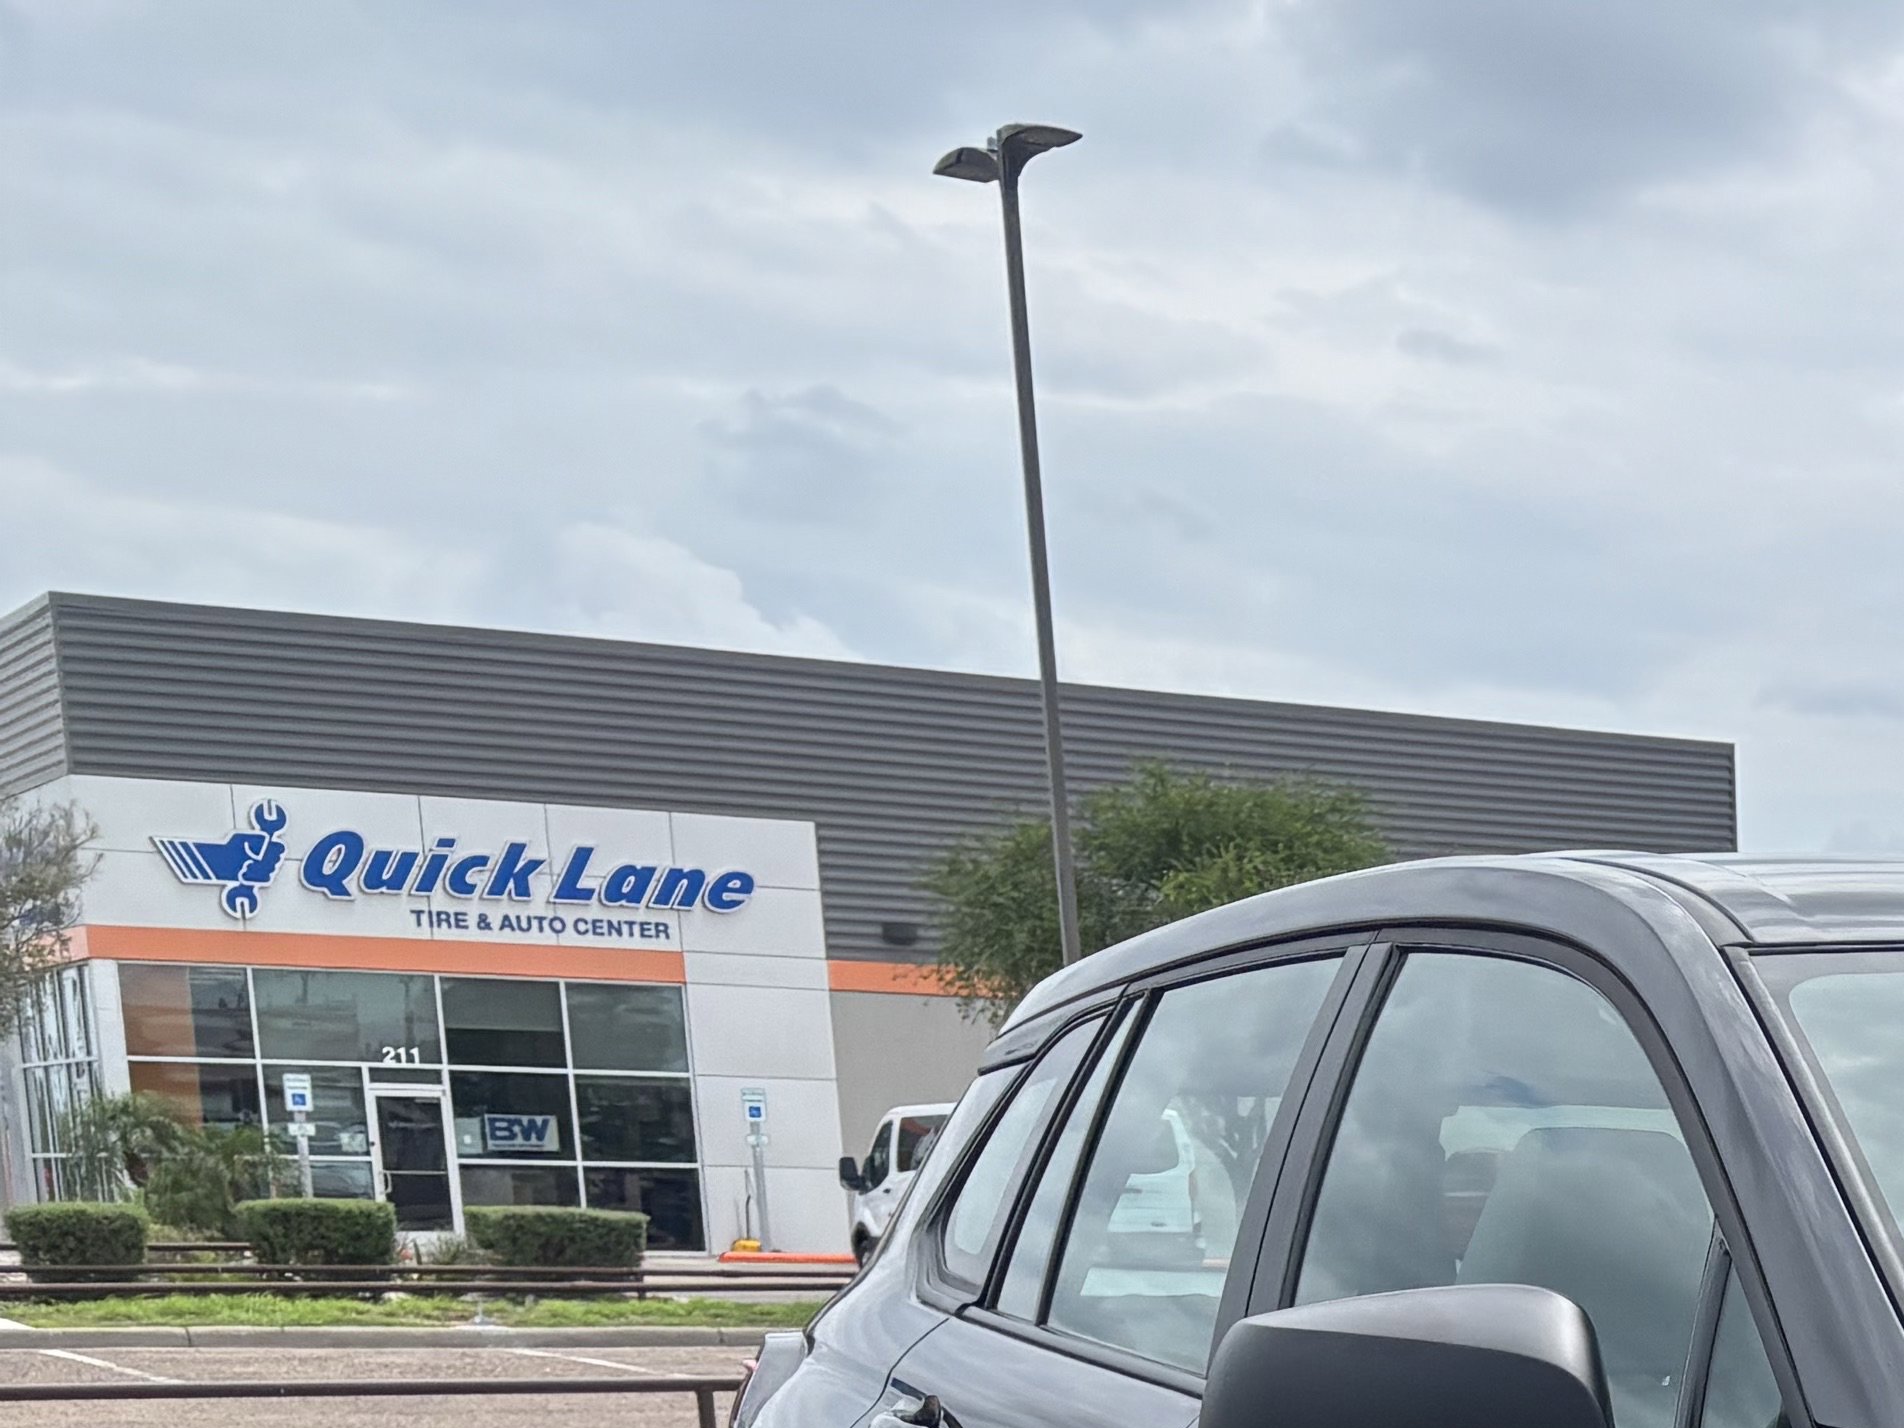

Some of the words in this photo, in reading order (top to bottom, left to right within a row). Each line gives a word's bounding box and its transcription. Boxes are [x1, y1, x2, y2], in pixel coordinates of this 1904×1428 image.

[301, 830, 549, 900] Quick
[552, 846, 757, 911] Lane
[410, 909, 470, 931] TIRE
[476, 911, 493, 931] &
[499, 914, 567, 935] AUTO
[573, 917, 671, 940] CENTER
[382, 1046, 420, 1064] 211
